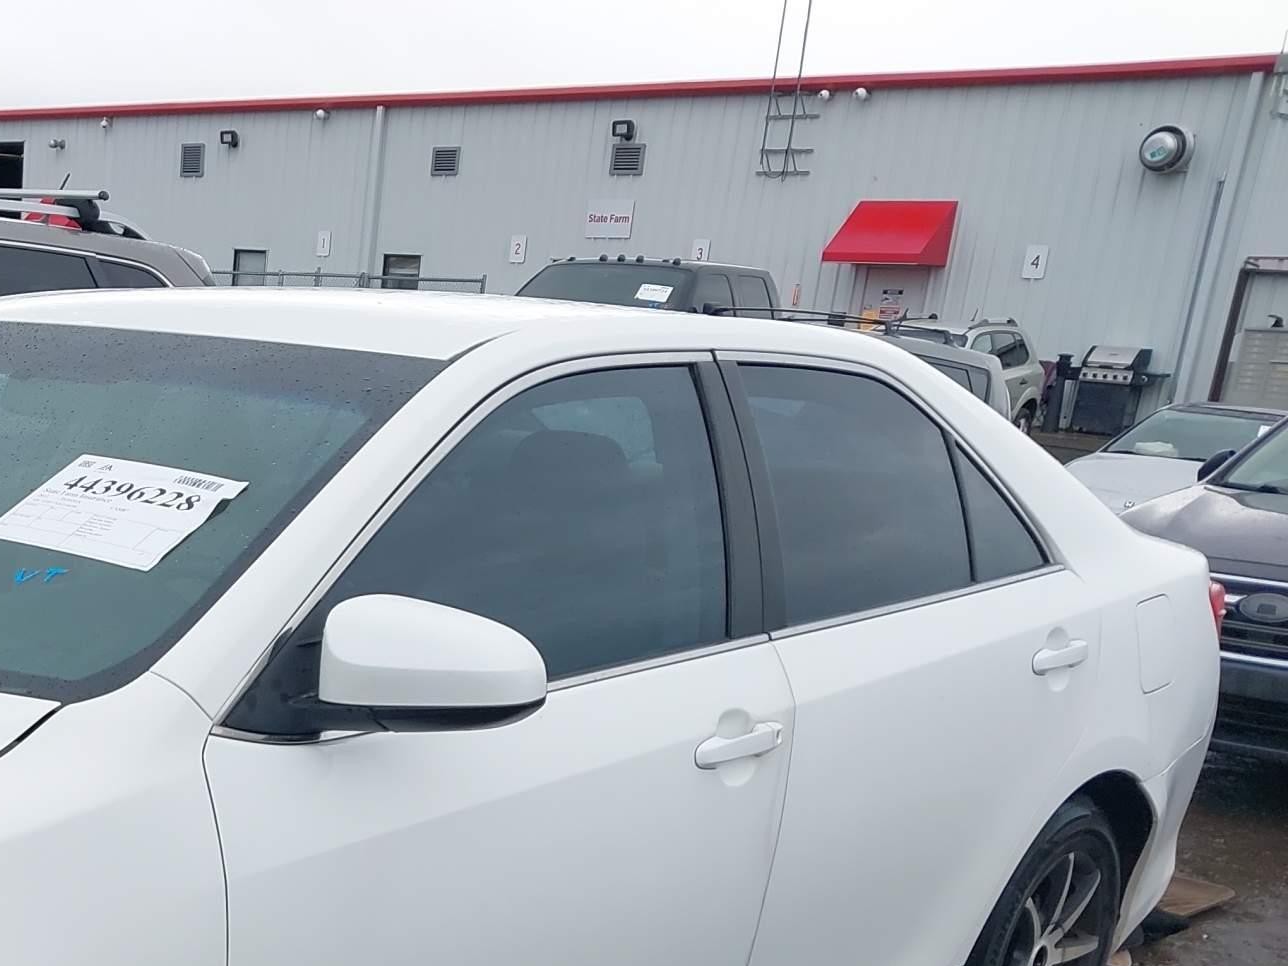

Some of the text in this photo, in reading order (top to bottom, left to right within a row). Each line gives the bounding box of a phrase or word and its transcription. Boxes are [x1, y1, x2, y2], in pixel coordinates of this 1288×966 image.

[588, 213, 630, 223] State Farm
[514, 242, 521, 255] 2
[696, 247, 704, 260] 3
[1030, 254, 1041, 269] 4
[63, 475, 201, 511] 44396228
